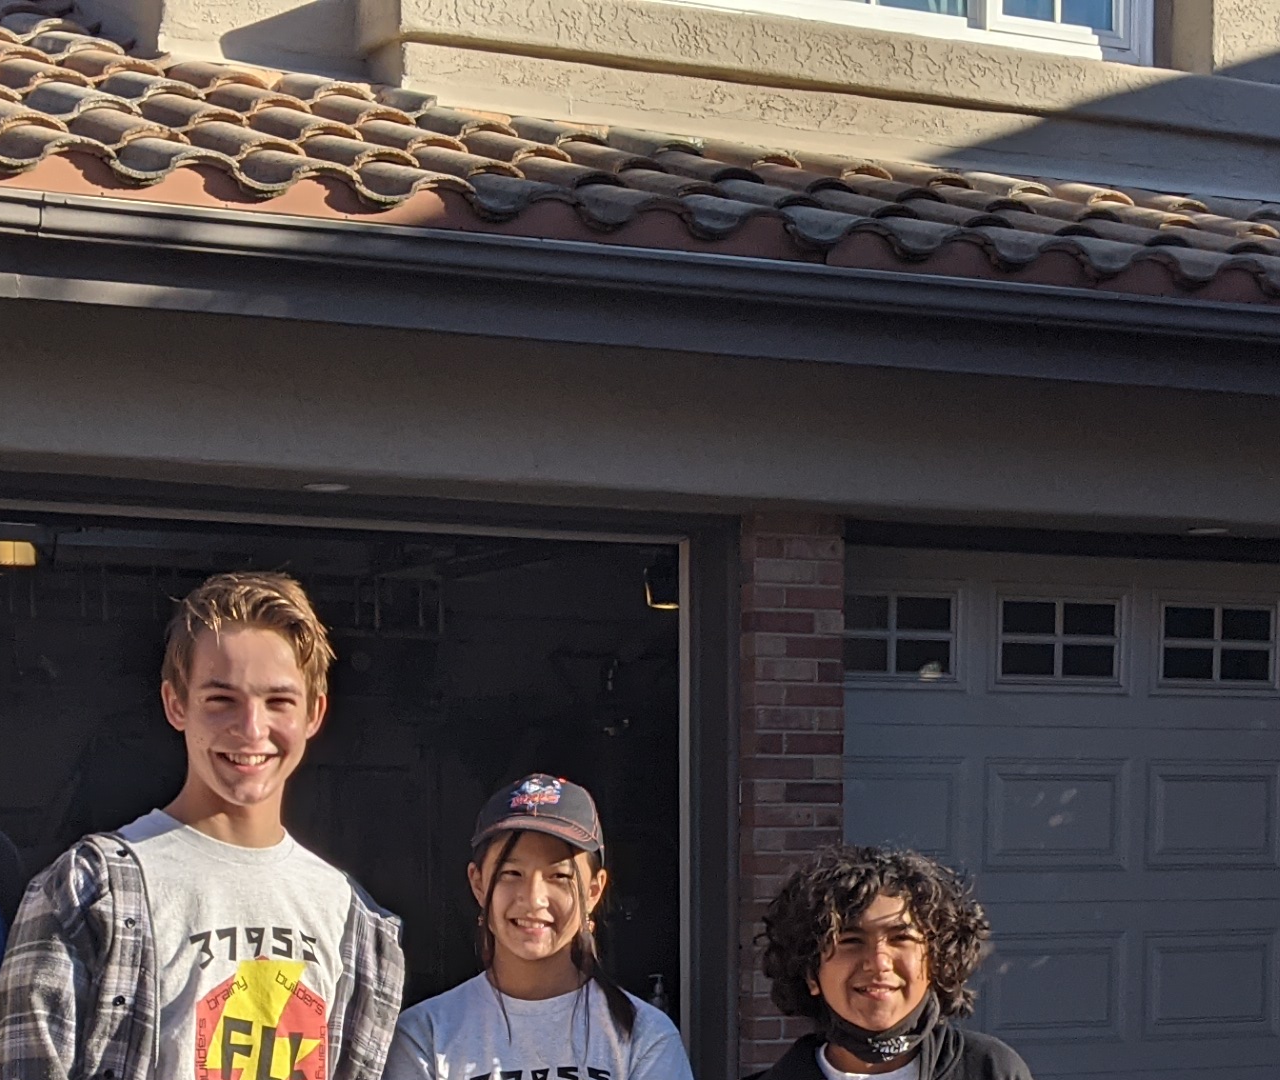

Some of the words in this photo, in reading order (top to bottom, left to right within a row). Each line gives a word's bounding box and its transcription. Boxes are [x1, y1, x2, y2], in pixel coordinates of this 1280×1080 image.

[189, 927, 320, 970] 37955
[206, 976, 248, 1011] brainy
[275, 970, 324, 1016] builders
